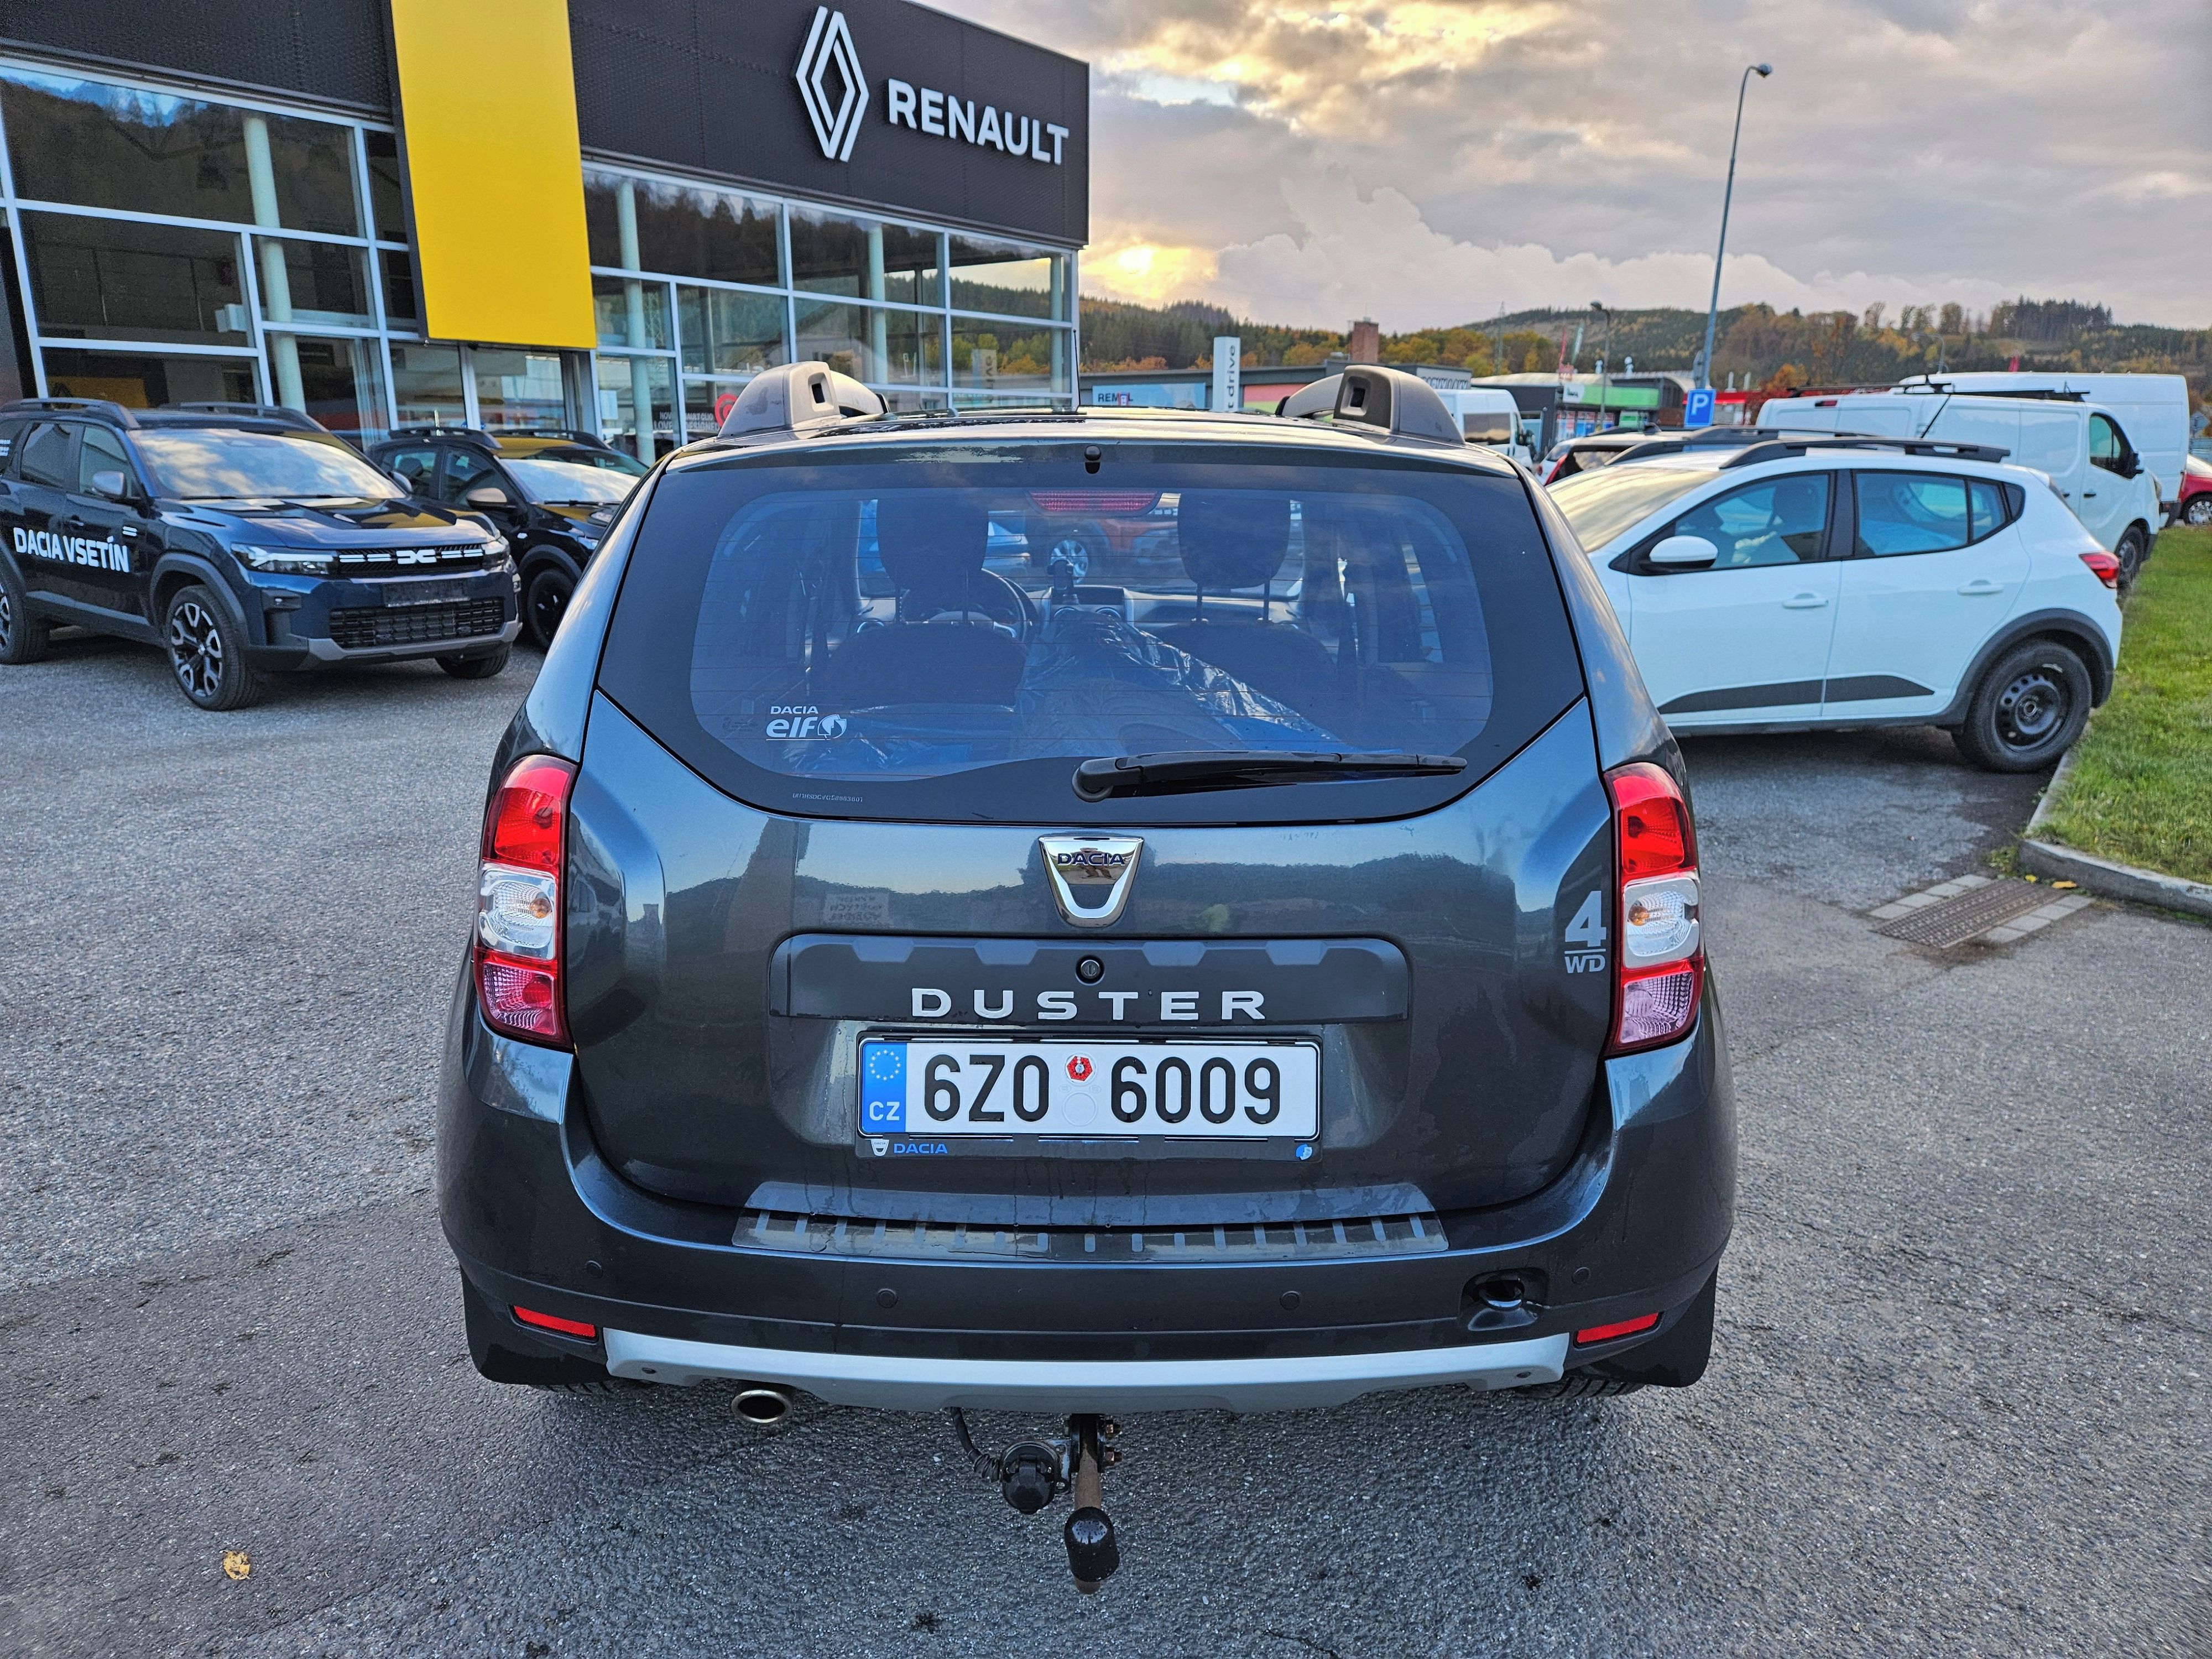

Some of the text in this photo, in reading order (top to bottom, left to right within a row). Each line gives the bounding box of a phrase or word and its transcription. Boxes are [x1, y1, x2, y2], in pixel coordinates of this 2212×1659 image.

[888, 79, 1069, 165] RENAULT
[1227, 345, 1235, 397] drive
[1692, 393, 1709, 415] P
[13, 527, 130, 573] DACIA VSETÍN
[770, 706, 818, 714] DACIA
[766, 716, 818, 738] elf
[1058, 853, 1125, 866] DACIA
[1565, 890, 1606, 947] 4
[1564, 954, 1605, 974] WD
[912, 988, 1265, 1020] DUSTER
[924, 1055, 1281, 1124] 6Z0 6009
[869, 1101, 900, 1121] CZ
[894, 1143, 948, 1154] DACIA
